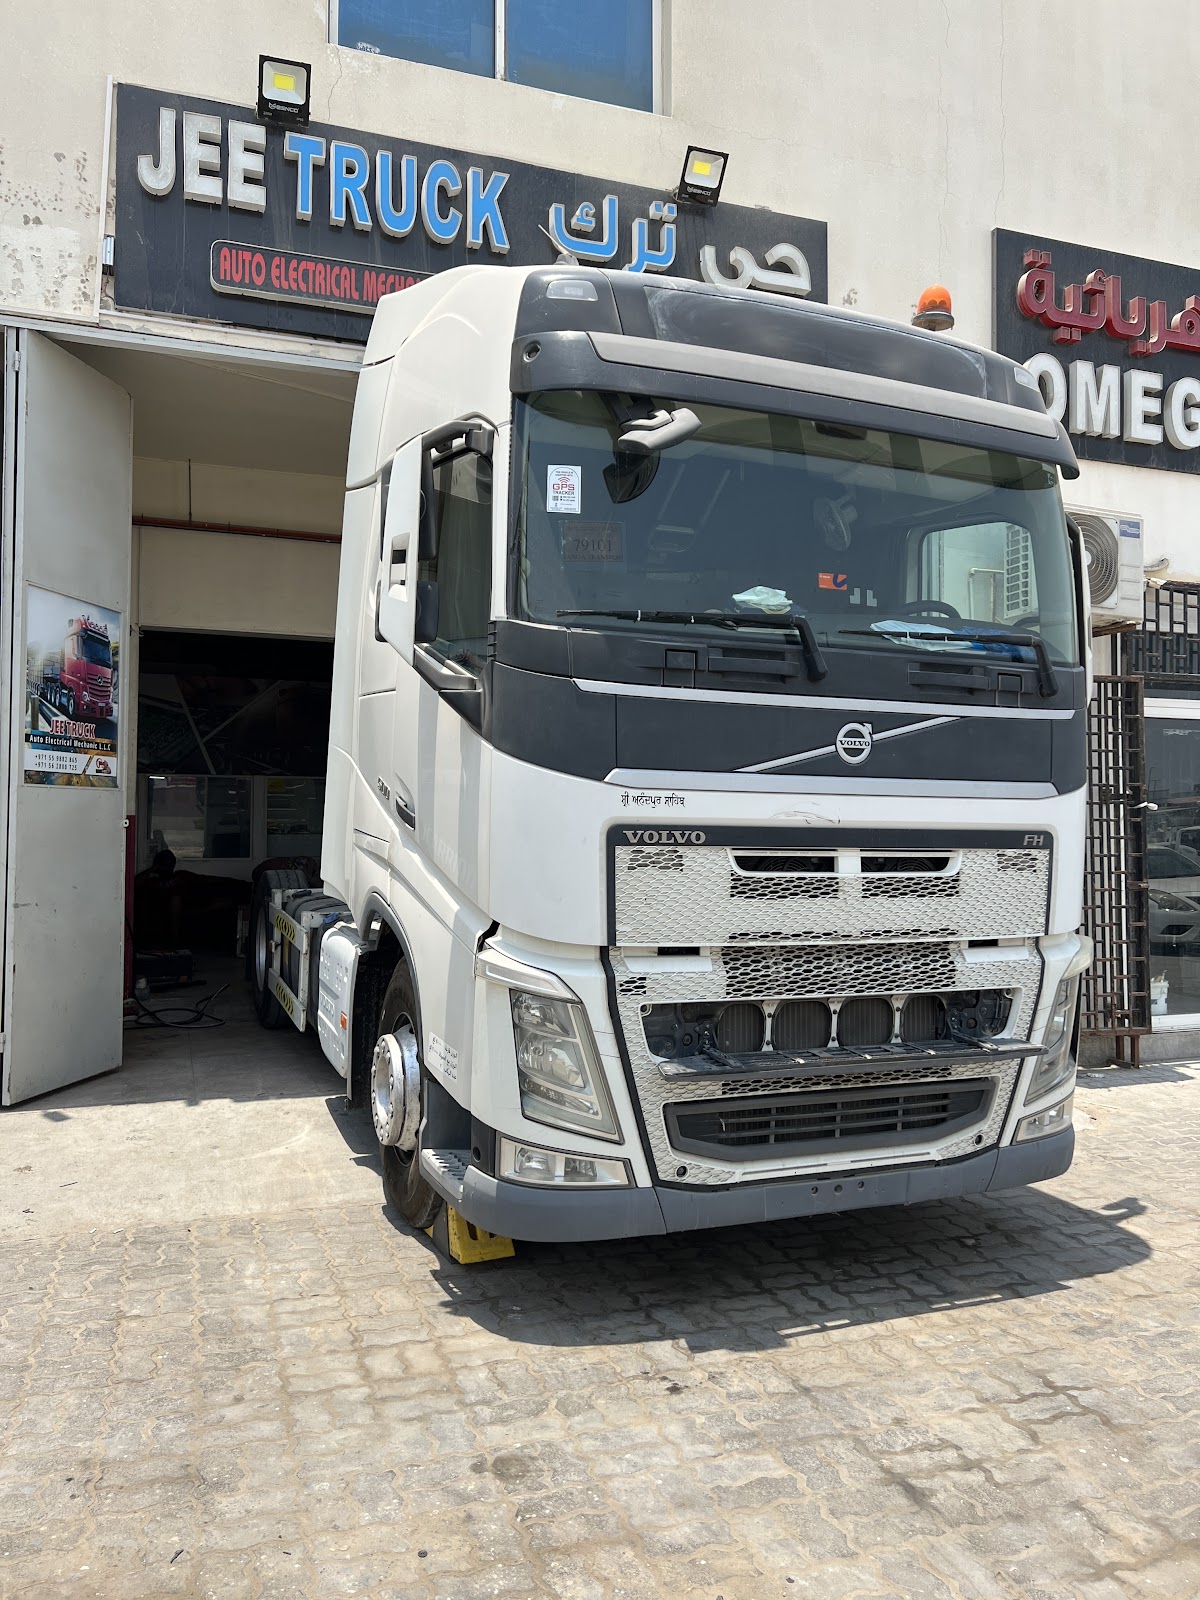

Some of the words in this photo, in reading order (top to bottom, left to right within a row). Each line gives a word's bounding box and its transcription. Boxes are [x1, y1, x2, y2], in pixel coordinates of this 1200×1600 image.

[137, 106, 267, 214] JEE
[282, 130, 511, 255] TRUCK
[219, 246, 266, 286] AUTO
[270, 256, 360, 301] ELECTRICAL
[552, 483, 575, 491] GPS
[49, 719, 64, 735] JEE
[65, 721, 96, 739] TRUCK
[29, 734, 44, 743] Auto
[45, 736, 72, 746] Electrical
[74, 740, 98, 749] Mechanic
[35, 753, 47, 761] +971
[48, 754, 55, 762] 55
[622, 830, 706, 844] VOLVO
[1023, 834, 1045, 846] FH
